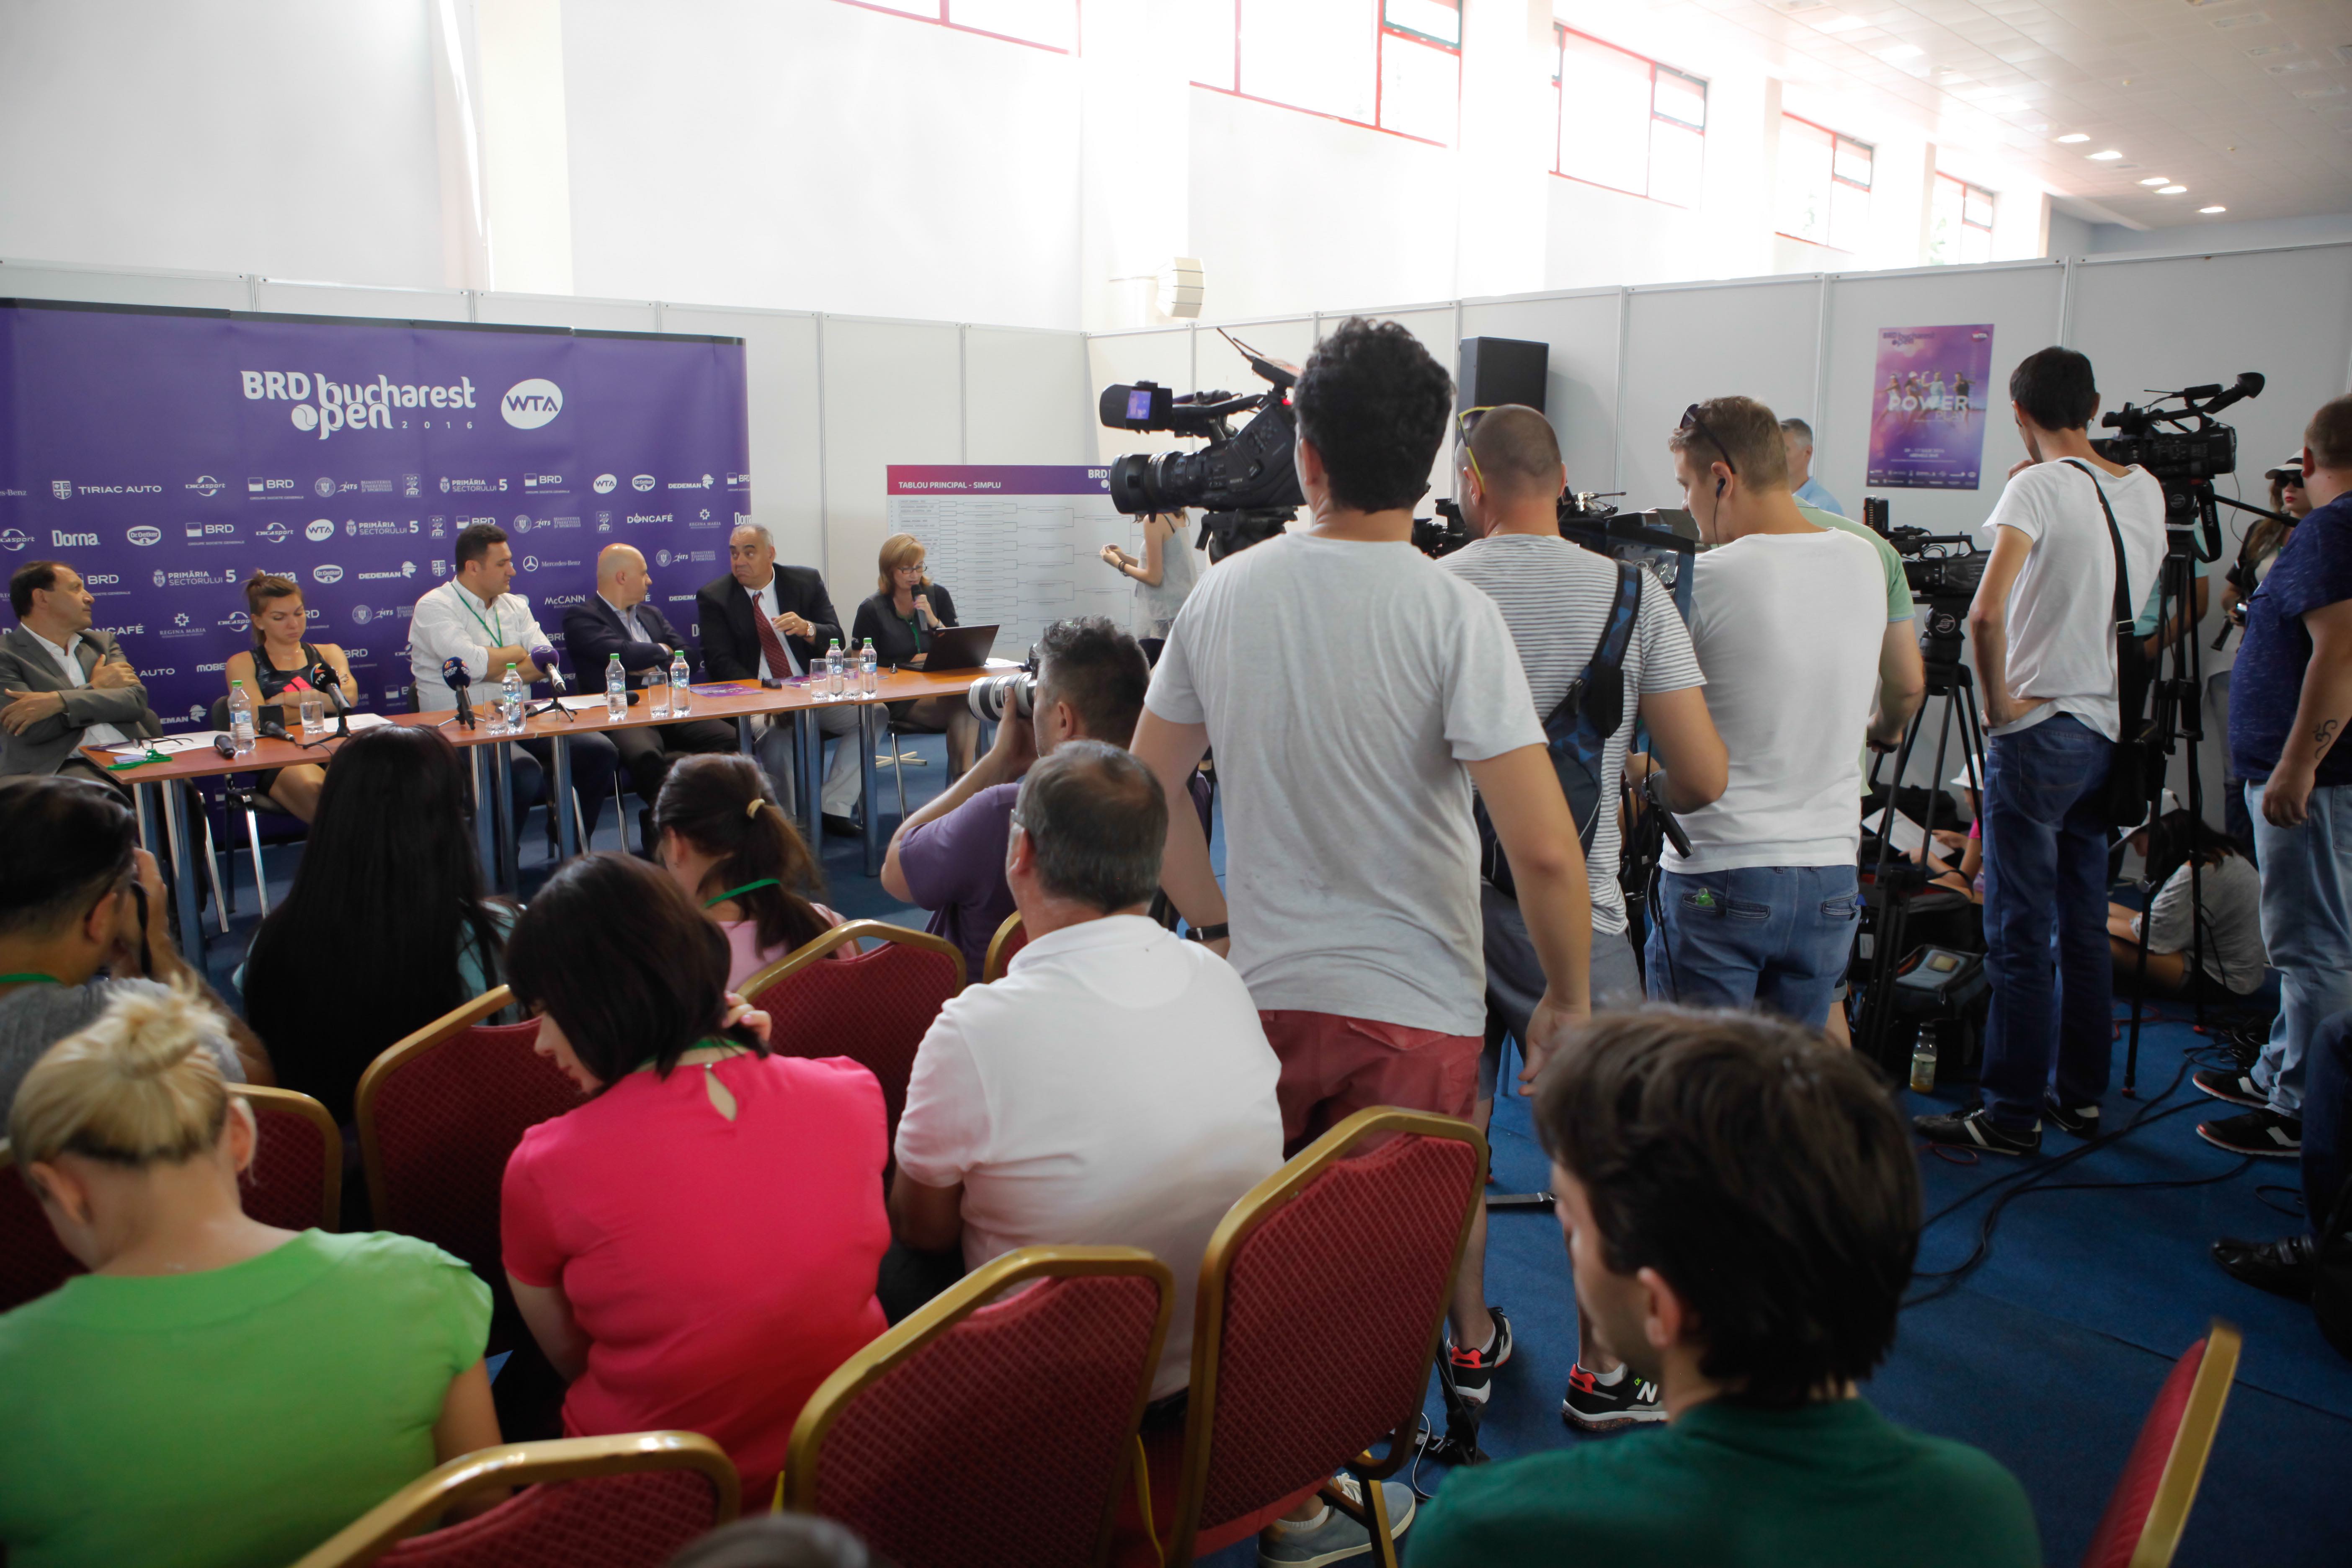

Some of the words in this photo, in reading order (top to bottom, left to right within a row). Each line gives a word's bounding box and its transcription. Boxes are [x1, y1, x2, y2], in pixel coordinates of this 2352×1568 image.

[240, 371, 310, 400] BRD
[314, 373, 476, 409] bucharest
[506, 395, 558, 412] WTA
[1888, 395, 1969, 411] POWER
[1088, 469, 1107, 479] BRD
[266, 479, 294, 489] BRD
[539, 475, 562, 484] BRD
[499, 479, 508, 491] 5
[627, 513, 673, 524] DONCAFÉ
[2205, 505, 2214, 527] SONY
[409, 520, 419, 533] 5
[472, 517, 496, 526] BRD
[205, 524, 235, 534] BRD
[52, 530, 98, 547] Dorna
[168, 570, 210, 579] PRIMĂRIA
[225, 570, 237, 583] 5
[358, 571, 401, 580] DEDEMAN
[87, 575, 119, 585] BRD
[169, 577, 223, 586] SECTORULUI
[545, 595, 585, 605] McCANN
[306, 610, 320, 619] RD
[139, 668, 175, 677] AUTO
[315, 673, 326, 685] TVR
[160, 716, 188, 725] EMAN
[1637, 1381, 1658, 1403] N
